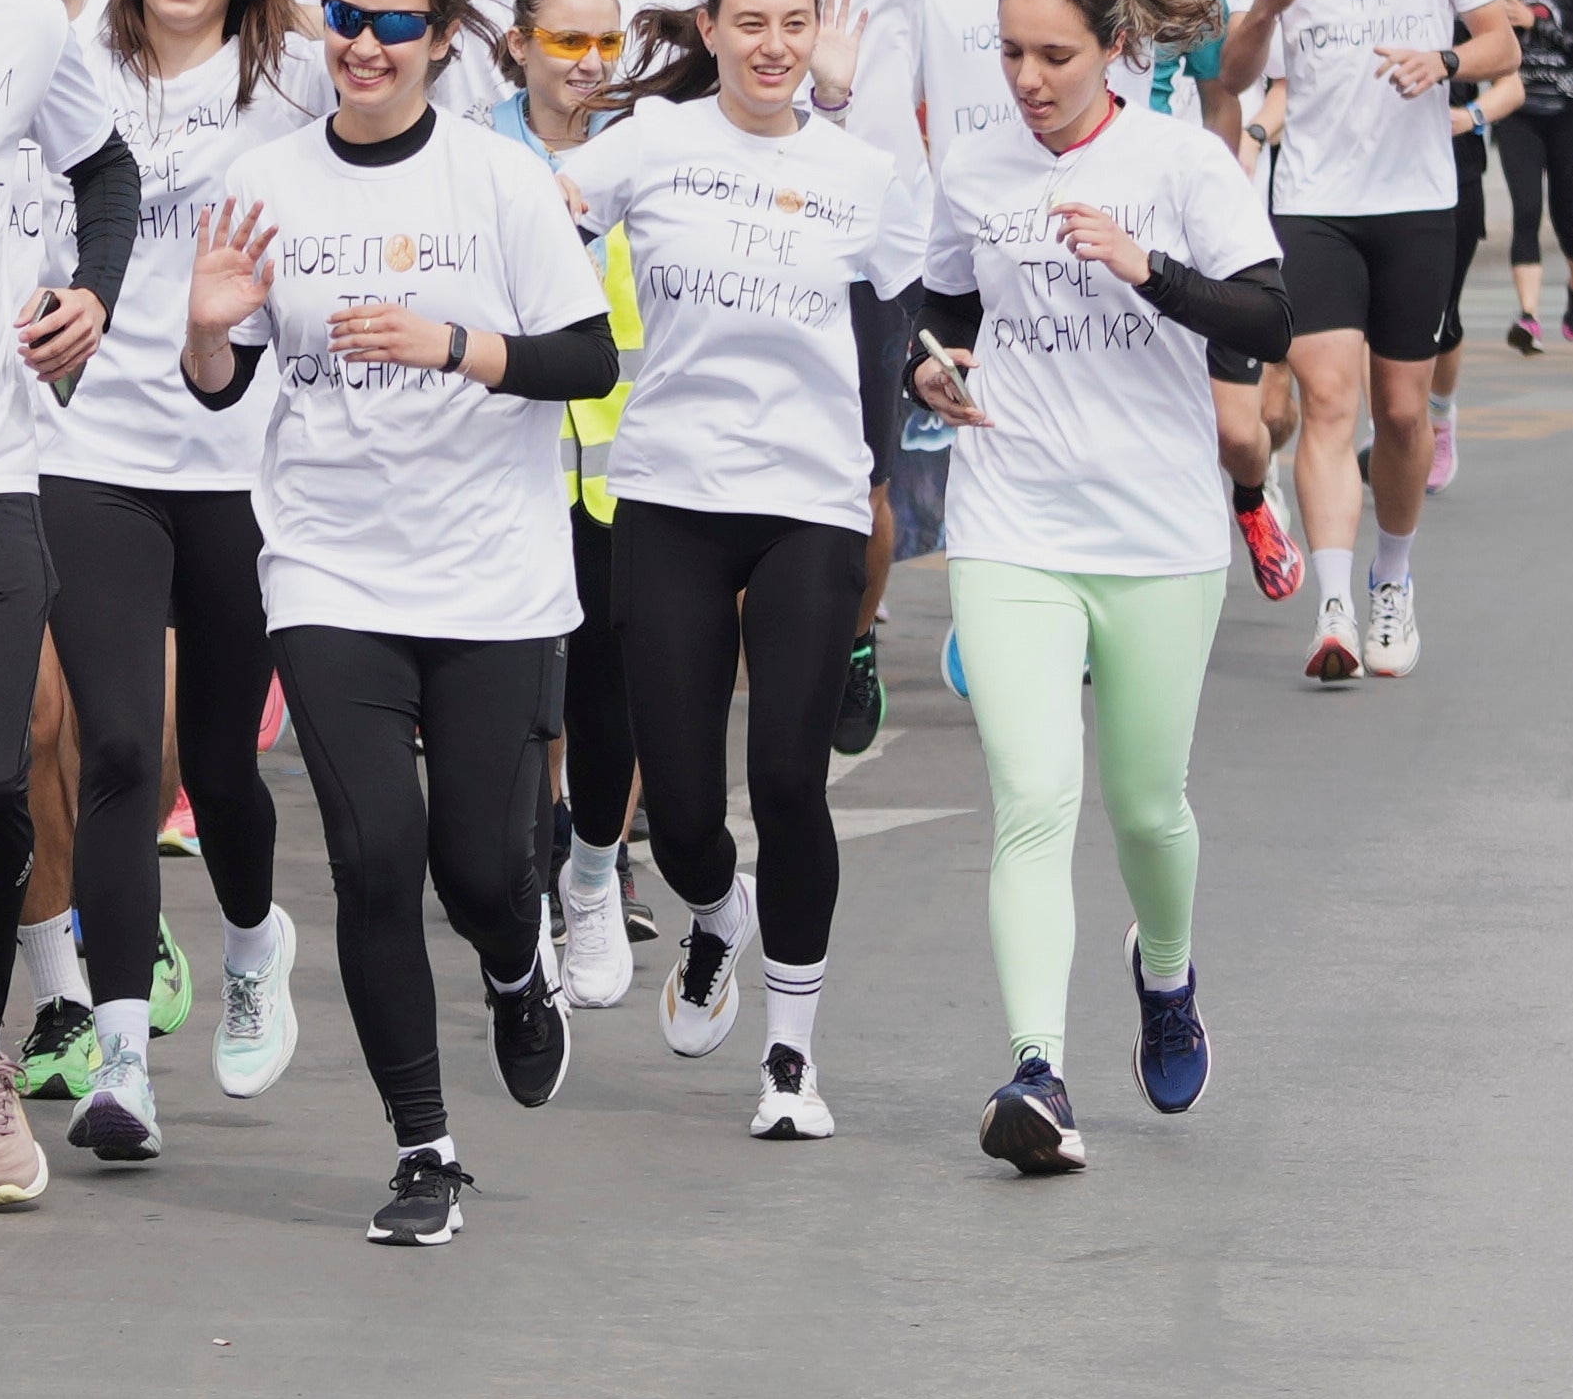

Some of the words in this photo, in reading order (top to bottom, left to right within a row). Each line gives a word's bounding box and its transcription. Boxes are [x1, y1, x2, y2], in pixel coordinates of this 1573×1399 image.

[726, 219, 801, 266] ТРЧЕ
[650, 264, 780, 317] ПОЧАСНИ
[1020, 260, 1098, 297] ТРЧЕ
[991, 315, 1092, 353] ОЧАСНИ
